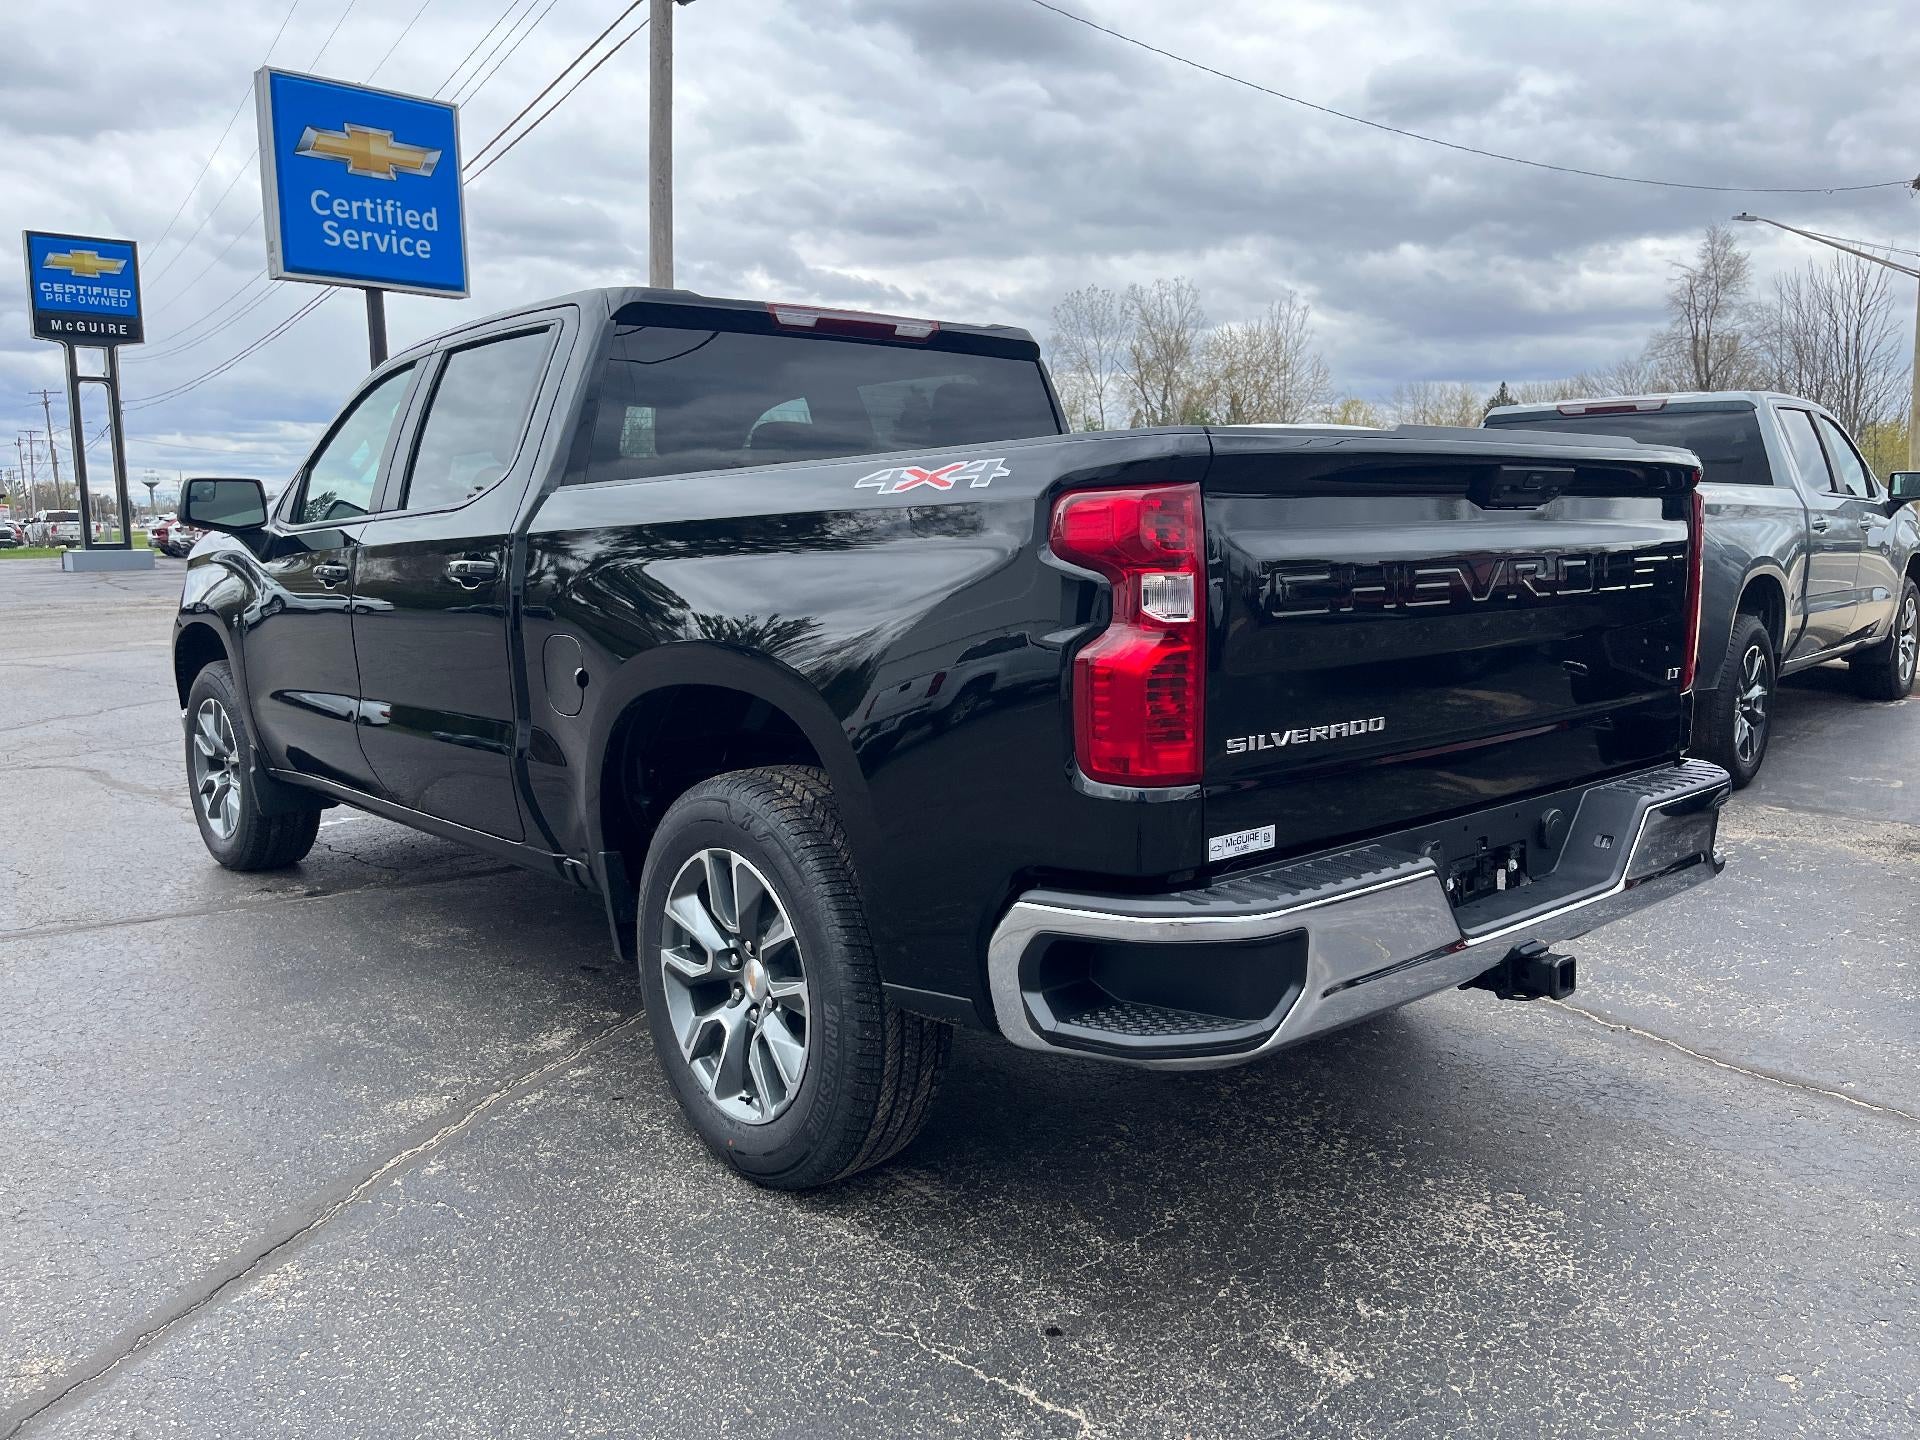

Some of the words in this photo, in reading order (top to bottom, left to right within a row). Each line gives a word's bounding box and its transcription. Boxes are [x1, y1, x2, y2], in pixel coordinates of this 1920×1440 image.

[310, 189, 438, 232] Certified
[322, 220, 431, 259] Service
[40, 282, 132, 299] CERTIFIED
[45, 292, 128, 308] PRE-OWNED
[50, 319, 128, 335] McGUIRE
[1667, 667, 1681, 681] LT
[1226, 716, 1386, 755] SILVERADO
[1225, 831, 1260, 848] McGUIRE
